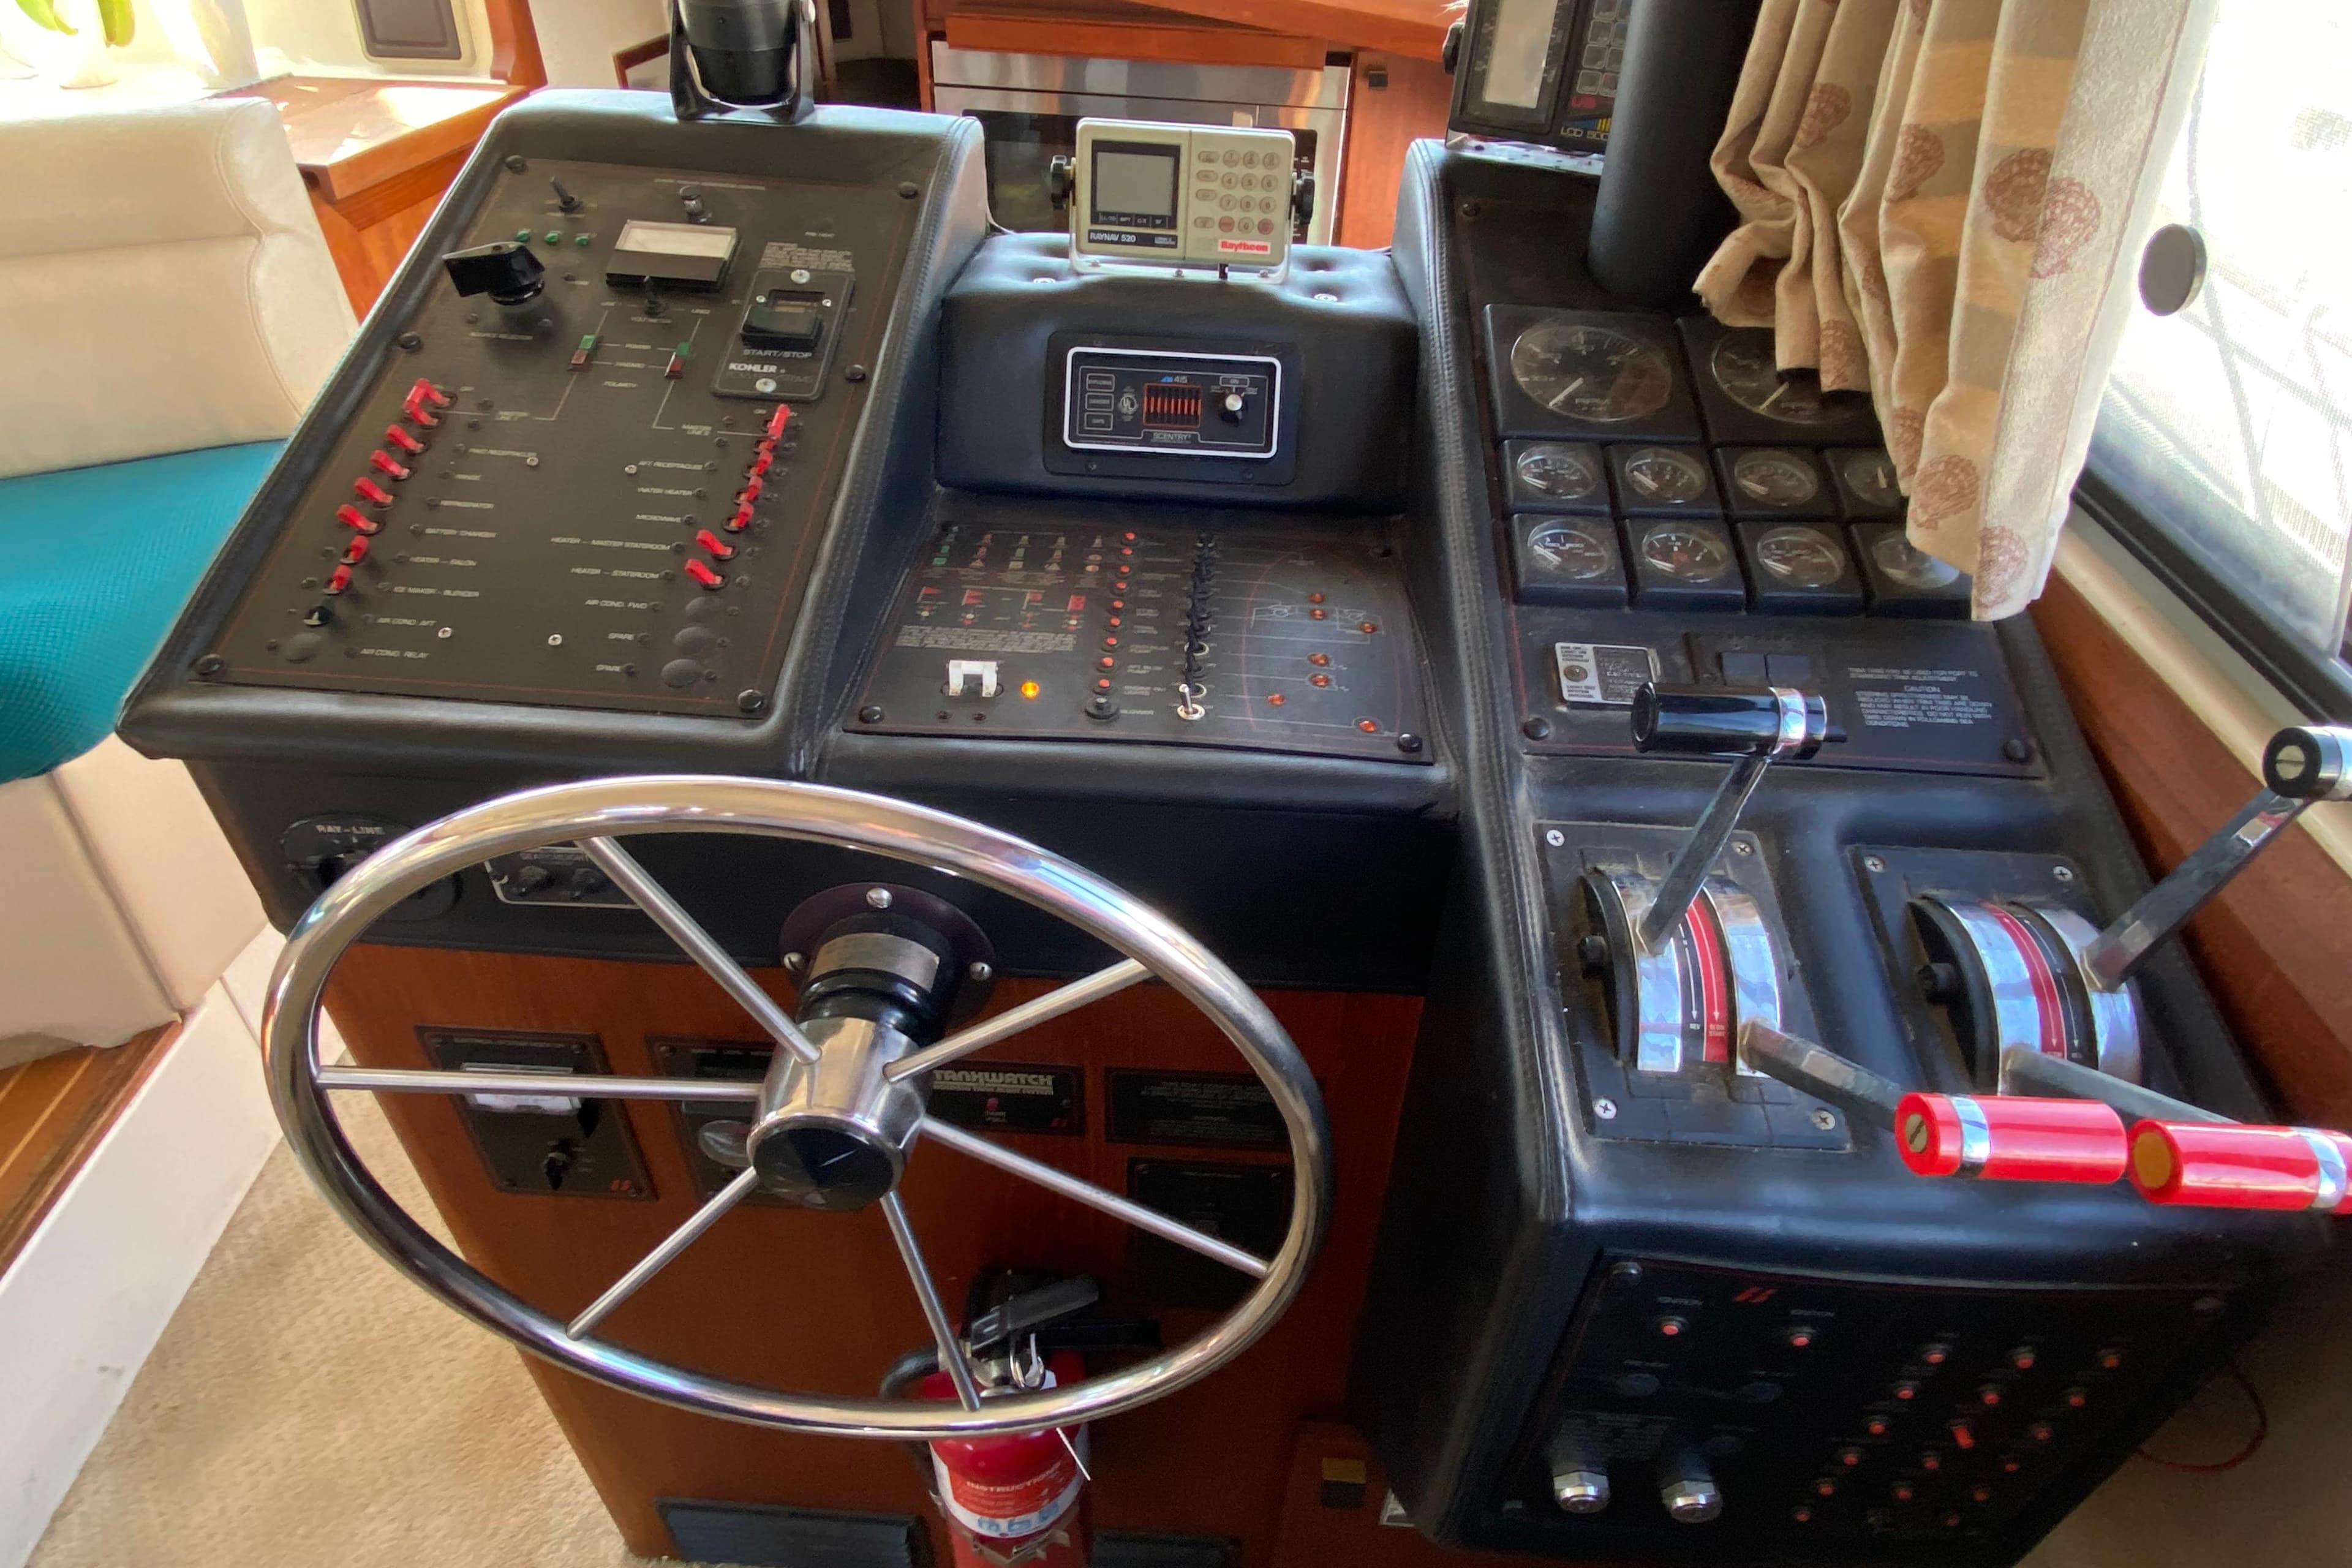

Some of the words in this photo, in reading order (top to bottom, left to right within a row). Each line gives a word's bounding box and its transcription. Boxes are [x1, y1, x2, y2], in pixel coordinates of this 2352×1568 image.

[1090, 232, 1118, 241] RAYNAV
[1121, 233, 1136, 242] 520
[1221, 241, 1268, 252] Raytheon
[743, 349, 812, 358] START/STOP
[728, 363, 778, 373] KOHLER
[636, 514, 682, 523] MICROWAVE
[611, 570, 660, 579] STATEROOM
[933, 1069, 1054, 1086] TANKWATCH
